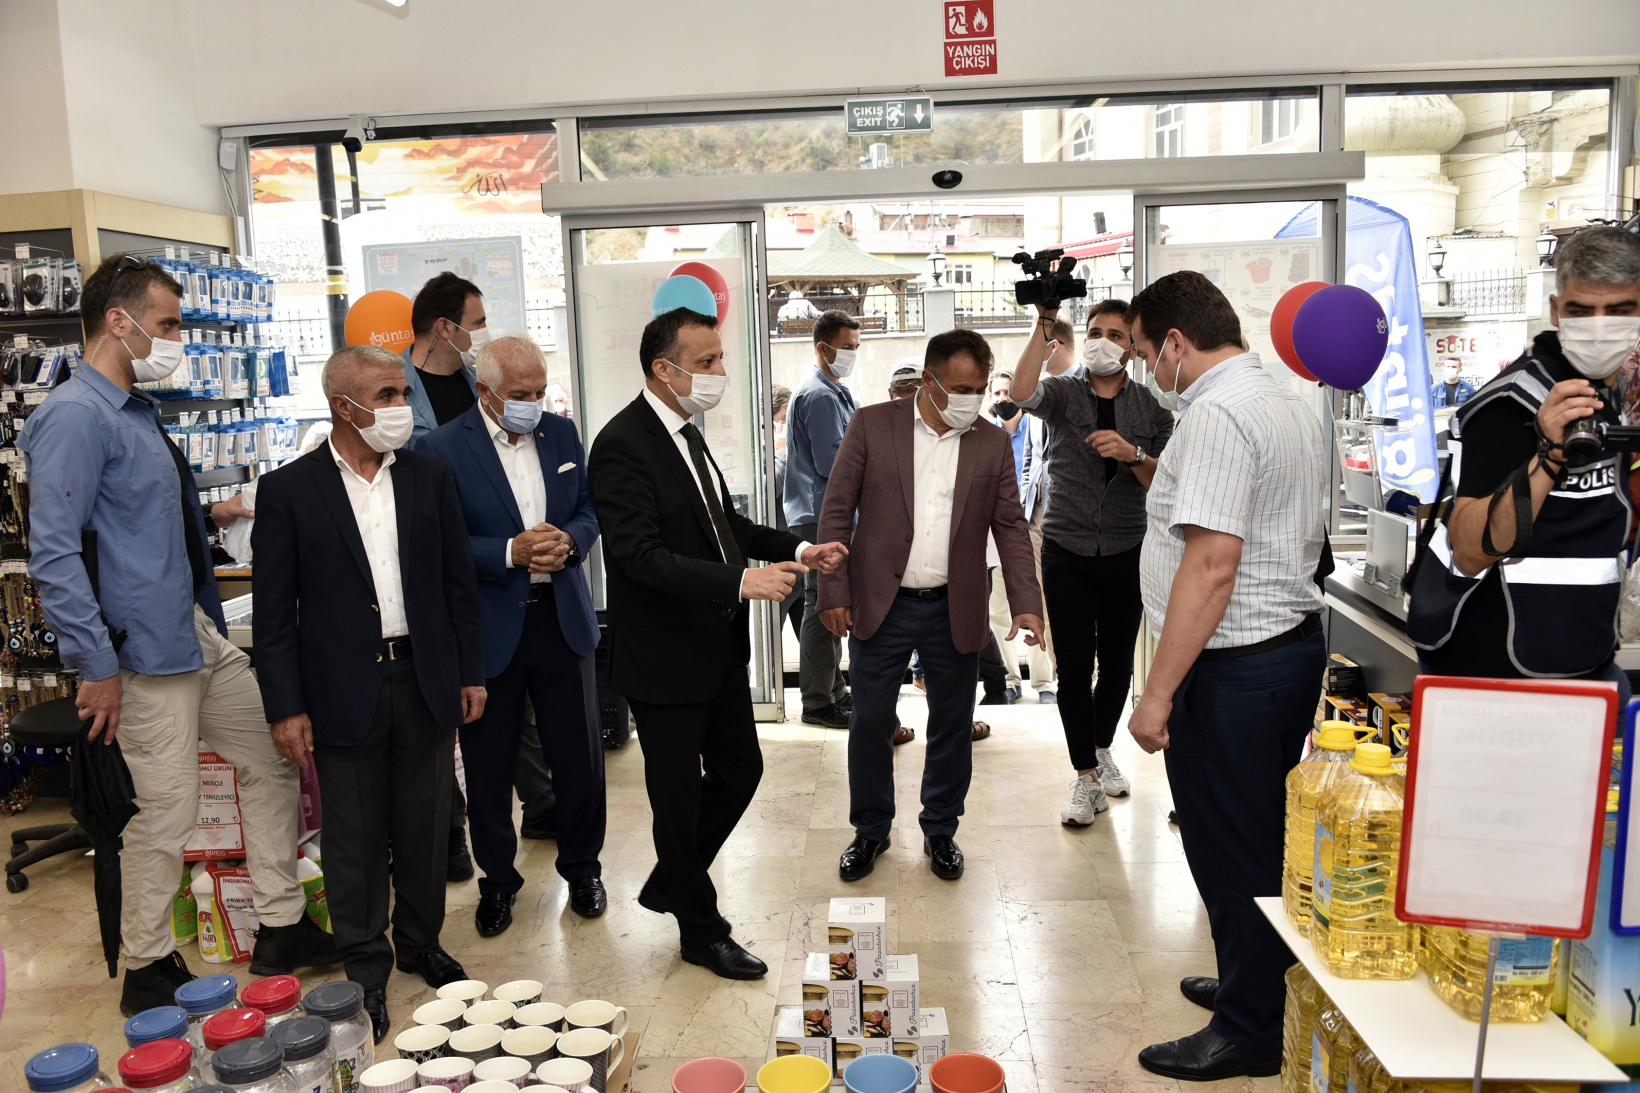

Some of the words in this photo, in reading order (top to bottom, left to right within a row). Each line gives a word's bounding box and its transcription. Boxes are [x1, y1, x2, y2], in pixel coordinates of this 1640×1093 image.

[946, 43, 995, 58] YANGIN
[953, 55, 990, 71] ÇIKIŞI
[853, 106, 884, 118] ÇIKIŞ
[856, 117, 883, 127] EXIT
[1566, 466, 1615, 490] POLİS
[201, 817, 221, 825] 12,90
